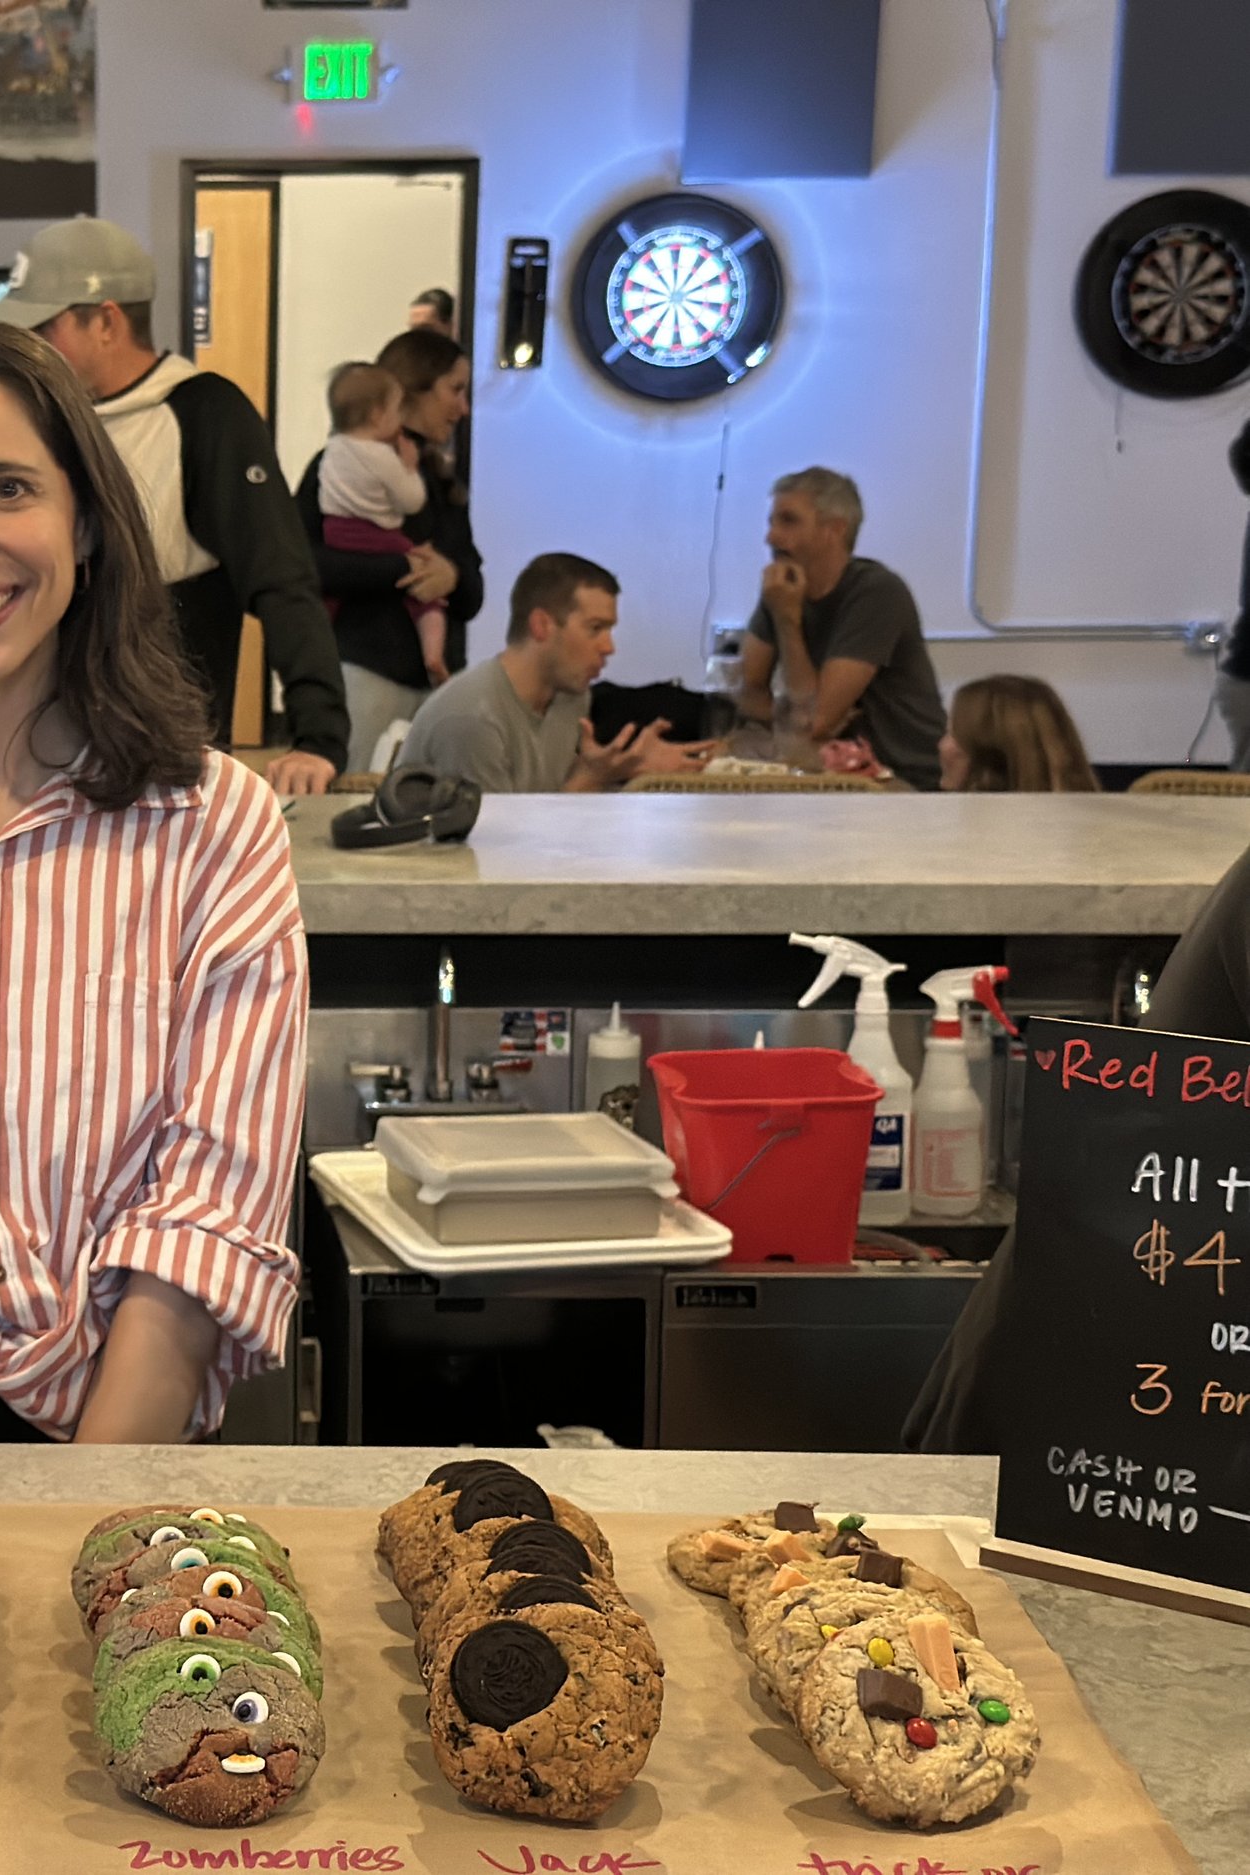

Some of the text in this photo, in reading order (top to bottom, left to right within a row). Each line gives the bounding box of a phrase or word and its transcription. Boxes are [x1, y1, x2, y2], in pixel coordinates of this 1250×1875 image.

[304, 43, 373, 100] EXIT
[1062, 1039, 1158, 1097] Red
[1131, 1152, 1199, 1202] All
[1133, 1218, 1242, 1296] $4
[1211, 1322, 1250, 1354] OR
[1130, 1363, 1173, 1415] 3
[1047, 1446, 1197, 1495] CASH OR
[1067, 1482, 1199, 1534] VENMO
[477, 1844, 662, 1875] Jack
